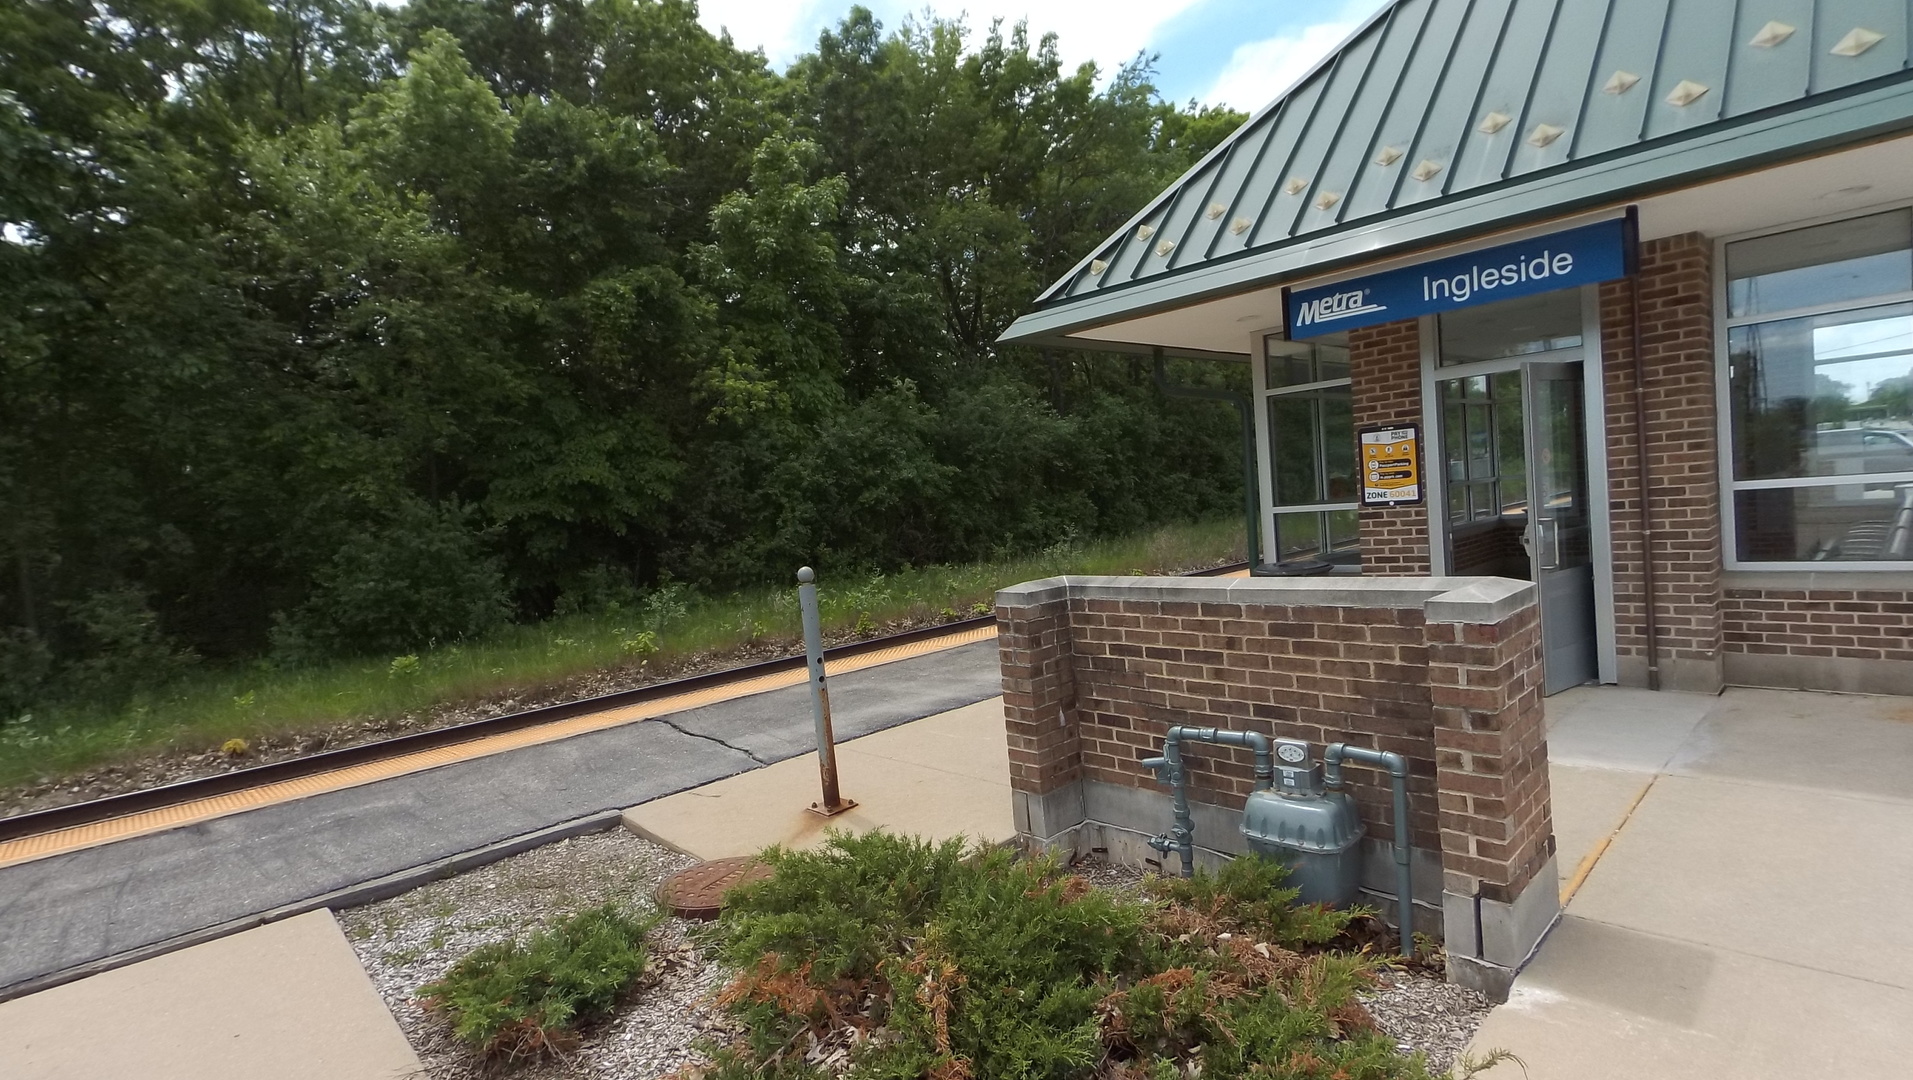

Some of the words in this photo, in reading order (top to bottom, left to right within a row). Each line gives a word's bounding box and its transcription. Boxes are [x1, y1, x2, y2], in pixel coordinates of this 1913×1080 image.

[1423, 250, 1573, 302] Ingleside
[1296, 290, 1363, 326] Metra
[1366, 491, 1388, 499] ZONE
[1389, 490, 1416, 498] 60041
